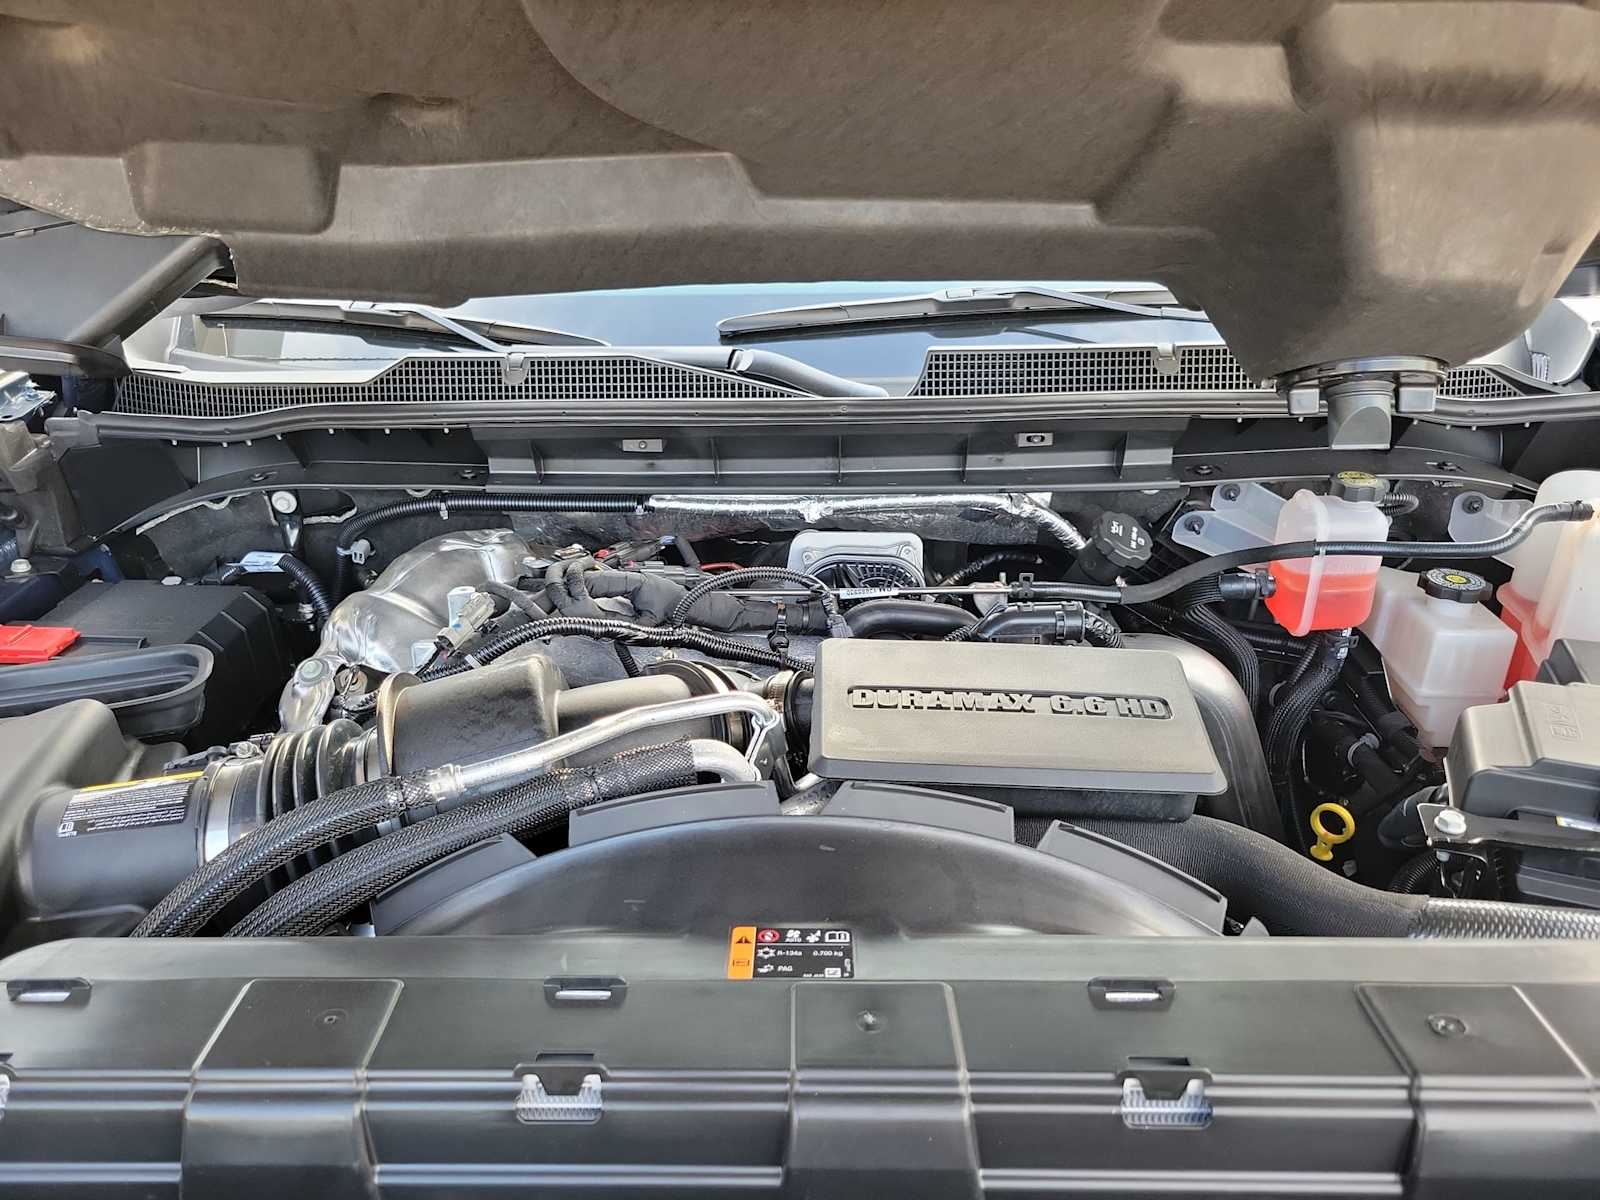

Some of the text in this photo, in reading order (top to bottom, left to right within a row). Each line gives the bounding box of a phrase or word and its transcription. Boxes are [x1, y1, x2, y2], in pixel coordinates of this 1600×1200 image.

[851, 687, 1171, 719] DURAMAX 6.6 HD
